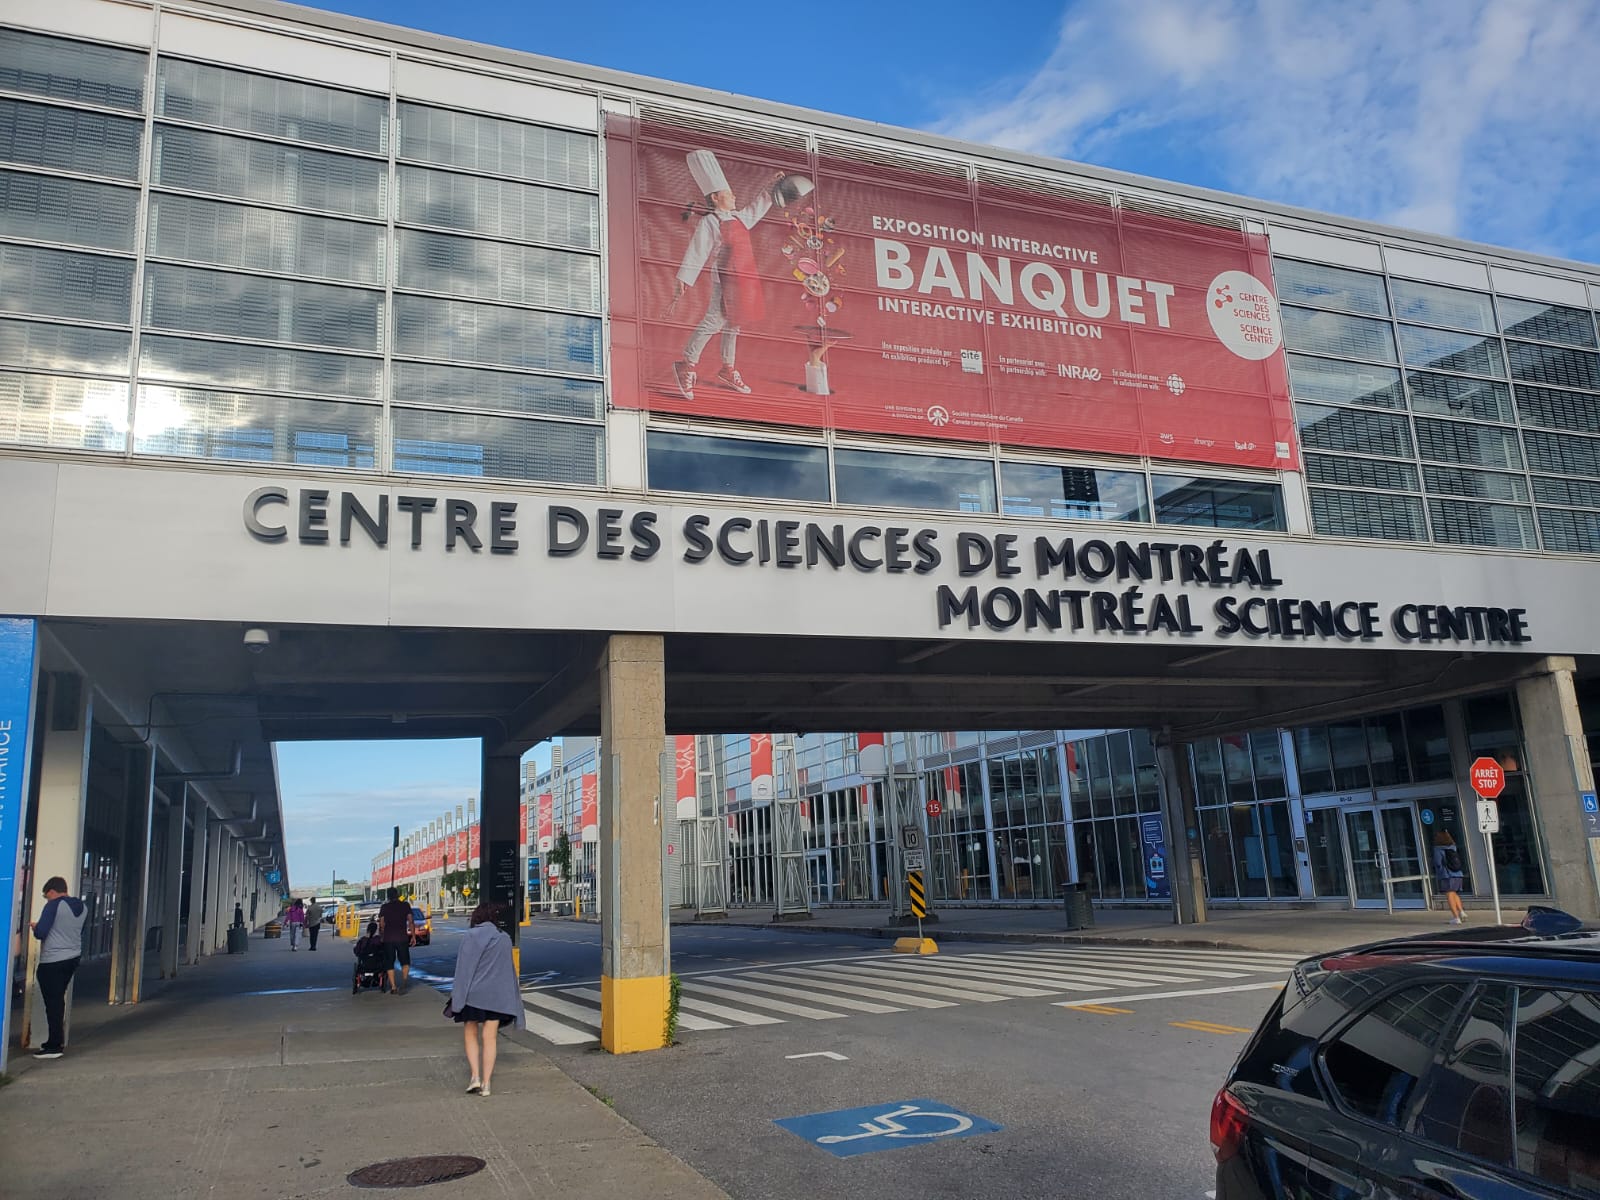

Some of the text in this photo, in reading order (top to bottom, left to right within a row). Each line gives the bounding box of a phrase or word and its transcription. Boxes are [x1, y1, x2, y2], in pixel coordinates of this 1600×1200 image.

[872, 215, 1098, 264] EXPOSITION INTERACTIVE
[874, 238, 1175, 328] BANQUET
[1239, 292, 1268, 304] CENTRE
[1233, 308, 1271, 321] SCIENCES
[1254, 303, 1269, 313] DES
[878, 297, 1102, 339] INTERACTIVE EXHIBITION
[1240, 324, 1272, 336] SCIENCE
[1244, 333, 1274, 344] CENTRE
[242, 485, 1284, 588] CENTRE DES SCIENCES DE MONTRÉAL
[937, 584, 1533, 643] MONTRÉAL SCIENCE CENTRE
[1474, 766, 1499, 779] ARRÊT
[1478, 779, 1498, 789] STOP
[929, 803, 940, 813] 15
[906, 832, 917, 845] 10
